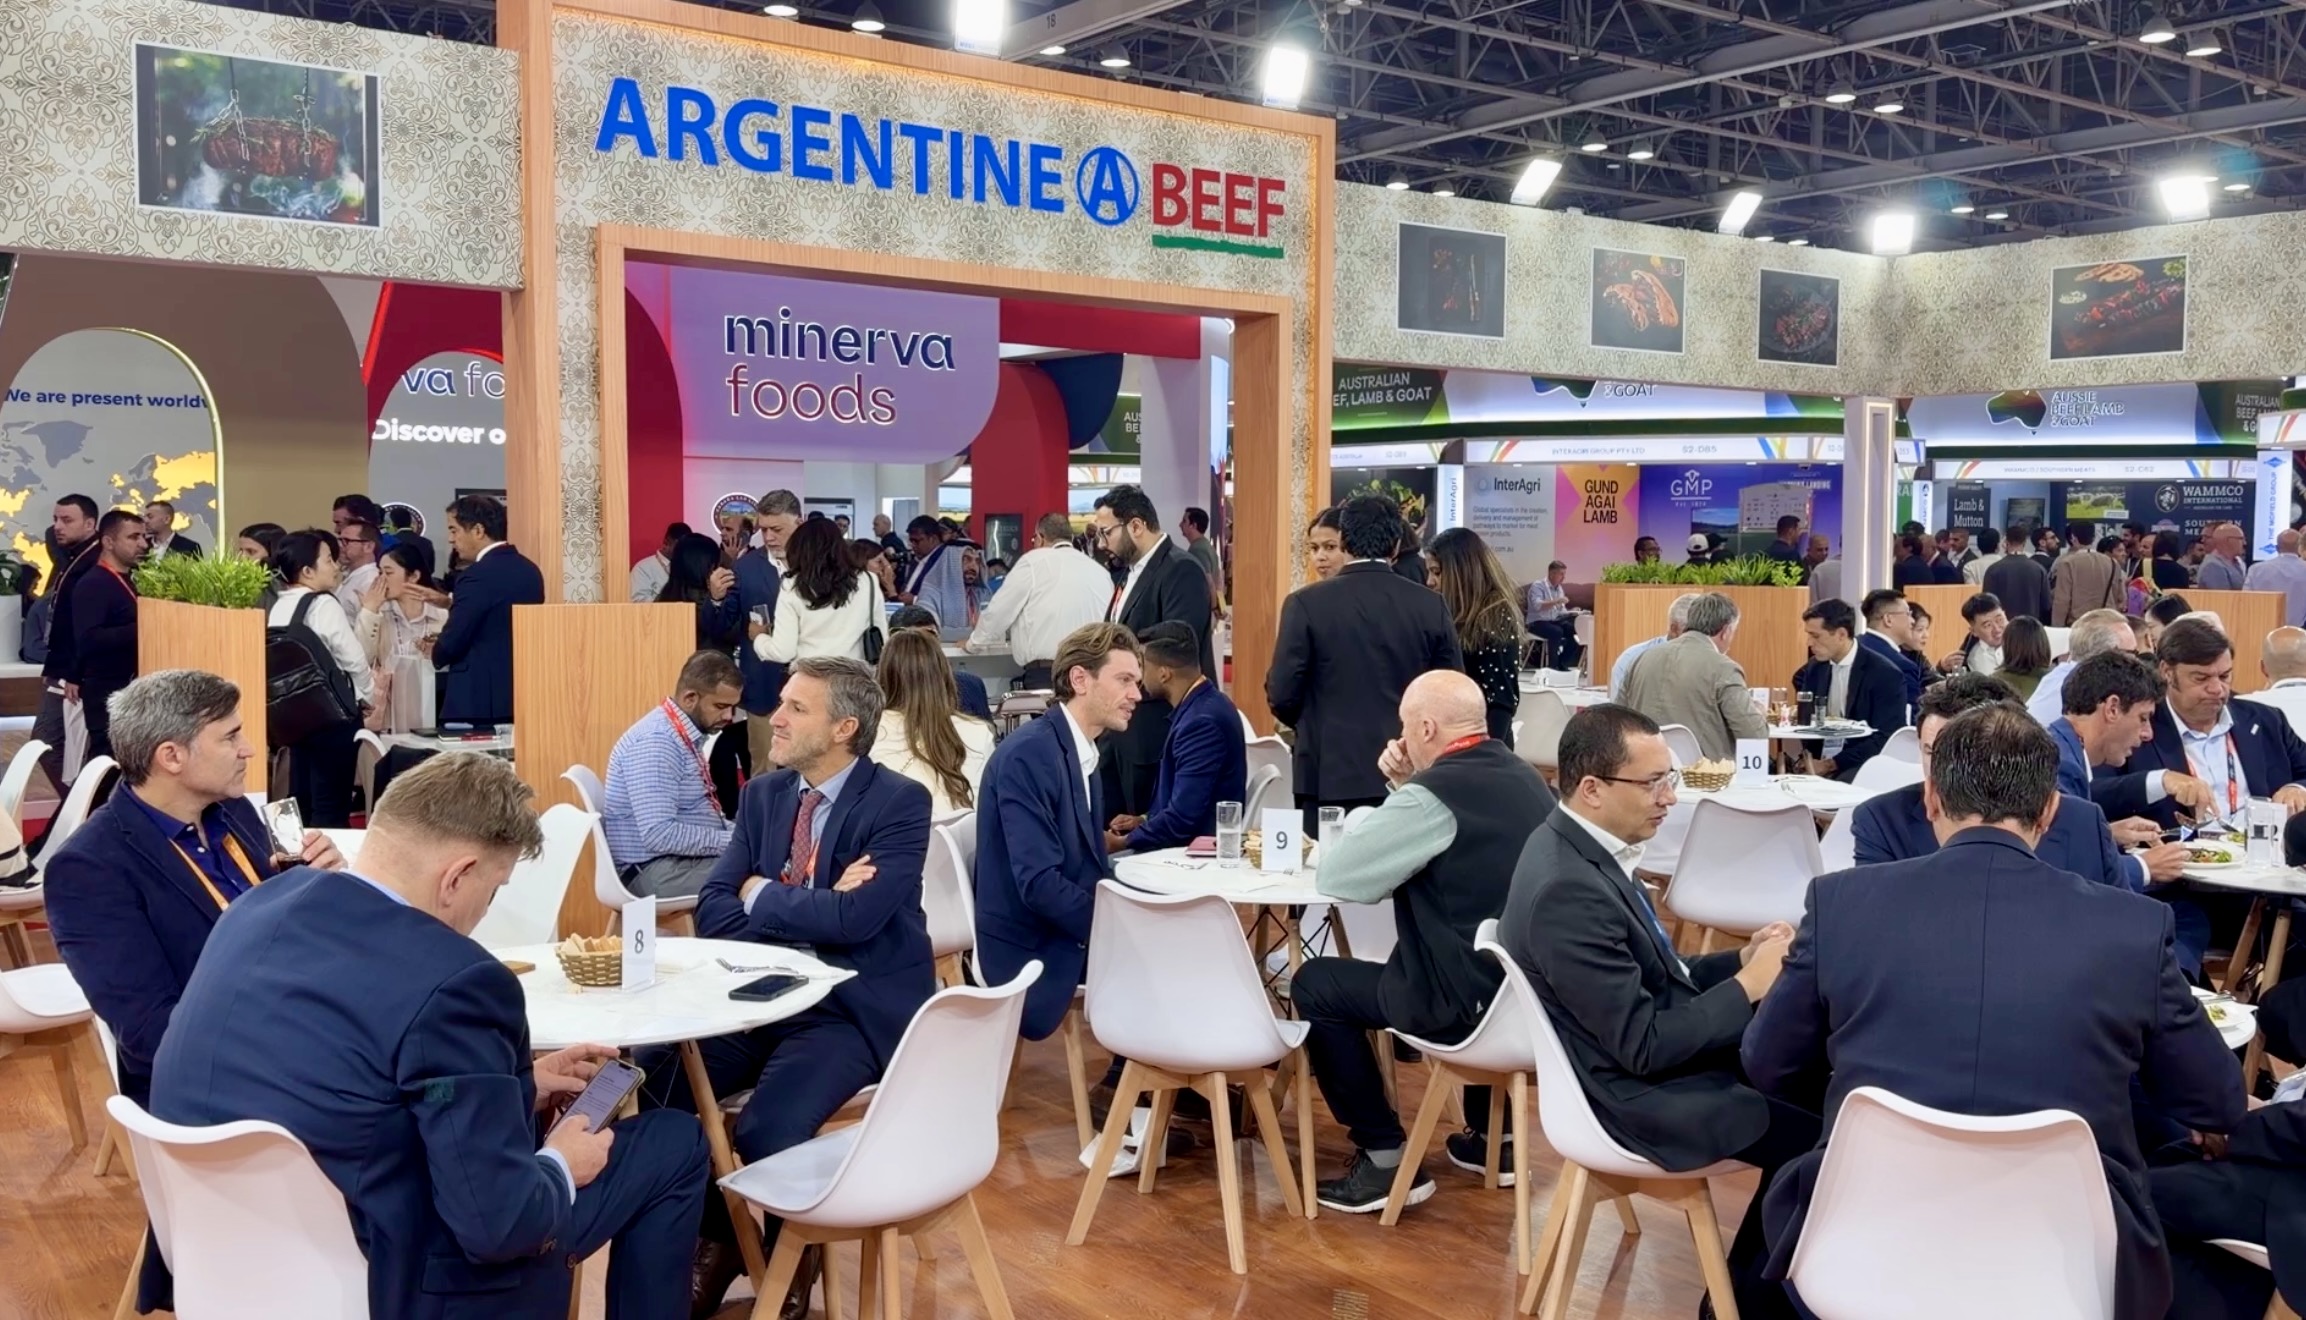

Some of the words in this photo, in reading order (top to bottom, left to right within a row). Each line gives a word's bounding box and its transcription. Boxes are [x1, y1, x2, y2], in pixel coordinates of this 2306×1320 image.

[1046, 14, 1057, 29] 18
[595, 77, 1065, 213] ARGENTINE
[1151, 163, 1286, 240] BEEF
[724, 306, 956, 371] minerva
[402, 368, 457, 396] va
[464, 361, 506, 399] fo
[1338, 371, 1411, 391] AUSTRALIAN
[36, 391, 67, 404] are
[72, 391, 144, 407] present
[726, 362, 898, 426] foods
[1351, 390, 1384, 406] LAMB
[1385, 389, 1394, 403] &
[1396, 386, 1432, 402] GOAT
[2051, 390, 2097, 403] AUSSIE
[2235, 393, 2281, 408] AUSTRALIAN
[2082, 401, 2125, 416] LAMB
[372, 418, 485, 444] Discover
[1125, 422, 1141, 433] BE
[2249, 420, 2257, 432] G
[1494, 477, 1541, 495] InterAgri
[1584, 479, 1619, 494] GUND
[1670, 479, 1713, 496] GMP
[2182, 485, 2244, 497] WAMMCO
[1585, 495, 1616, 509] AGAI
[1953, 498, 1977, 511] Lamb
[1978, 498, 1985, 511] &
[1583, 510, 1618, 523] LAMB
[1953, 514, 1984, 527] Mutton
[2184, 528, 2200, 536] ME
[1742, 755, 1762, 770] 10
[1275, 831, 1288, 850] 9
[634, 929, 644, 954] 8
